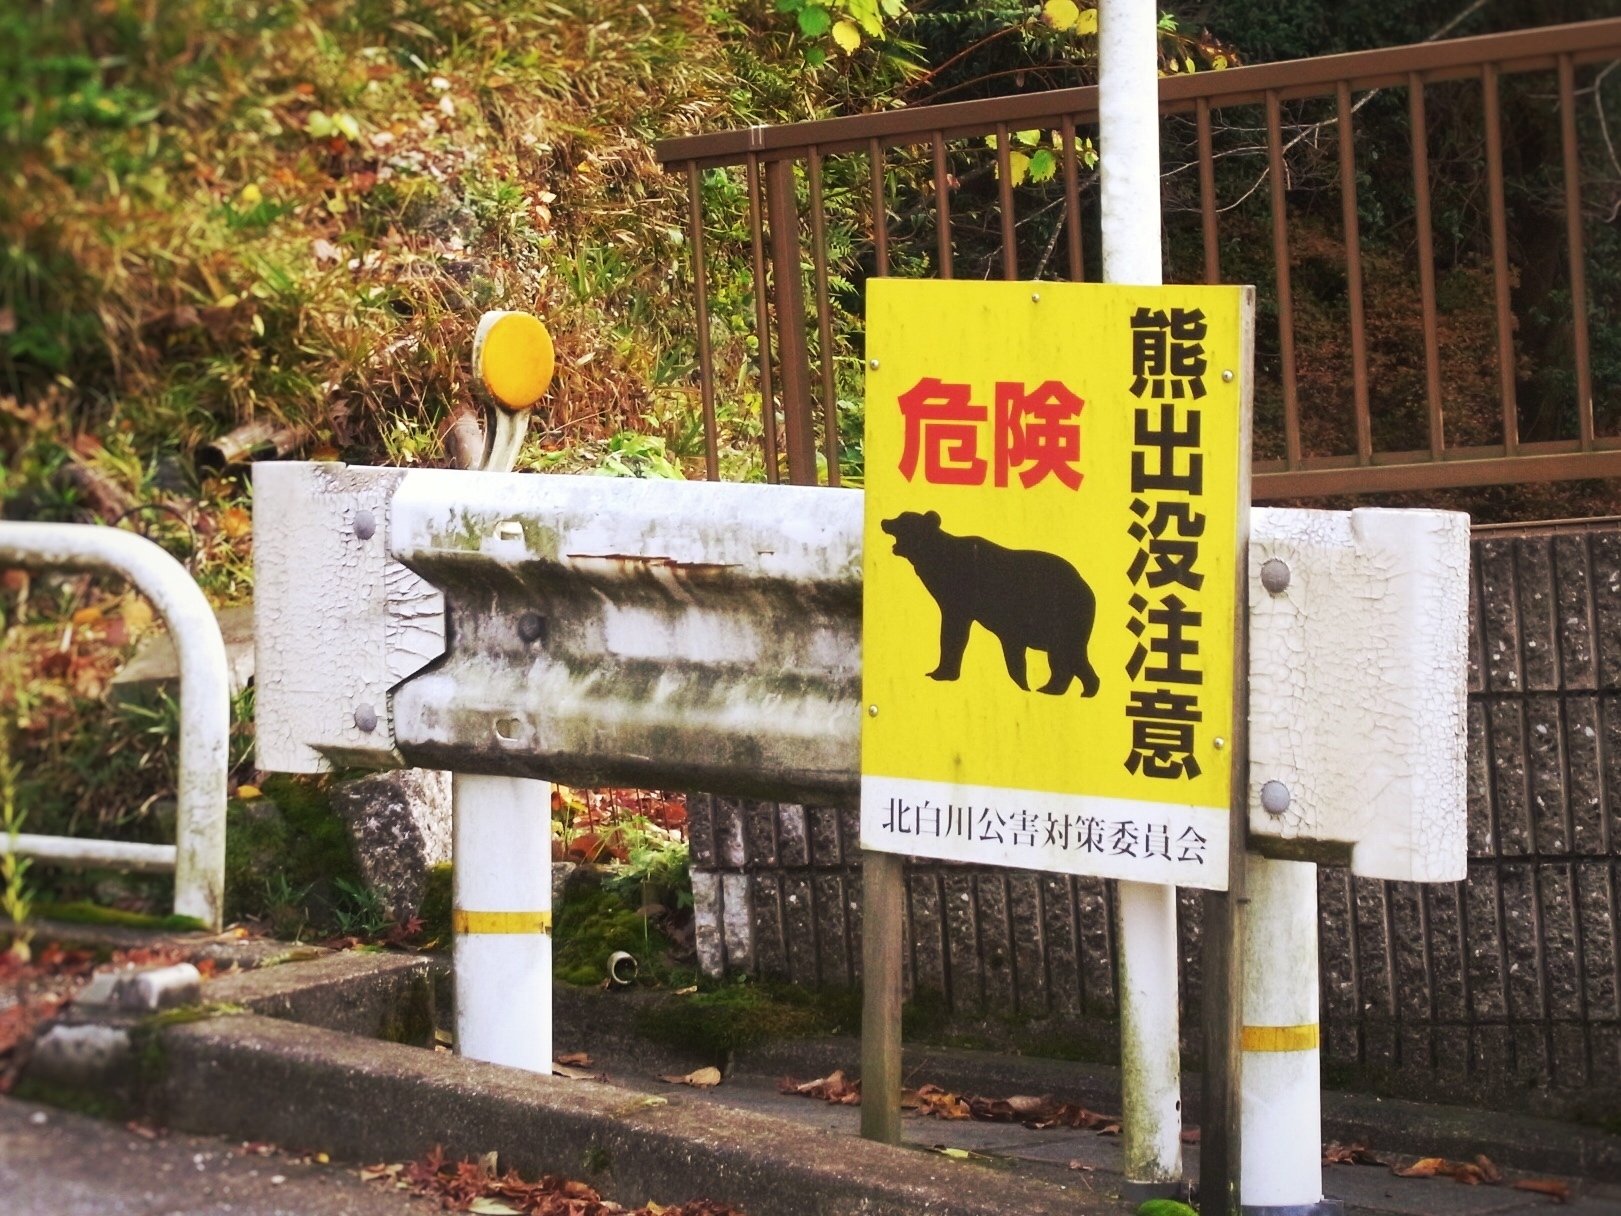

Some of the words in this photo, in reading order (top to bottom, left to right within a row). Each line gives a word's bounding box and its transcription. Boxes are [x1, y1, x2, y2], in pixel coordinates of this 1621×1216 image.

[897, 376, 1086, 492] 危険
[1123, 306, 1208, 780] 熊出没注意
[881, 796, 1208, 866] 北白川公害対策委員会
